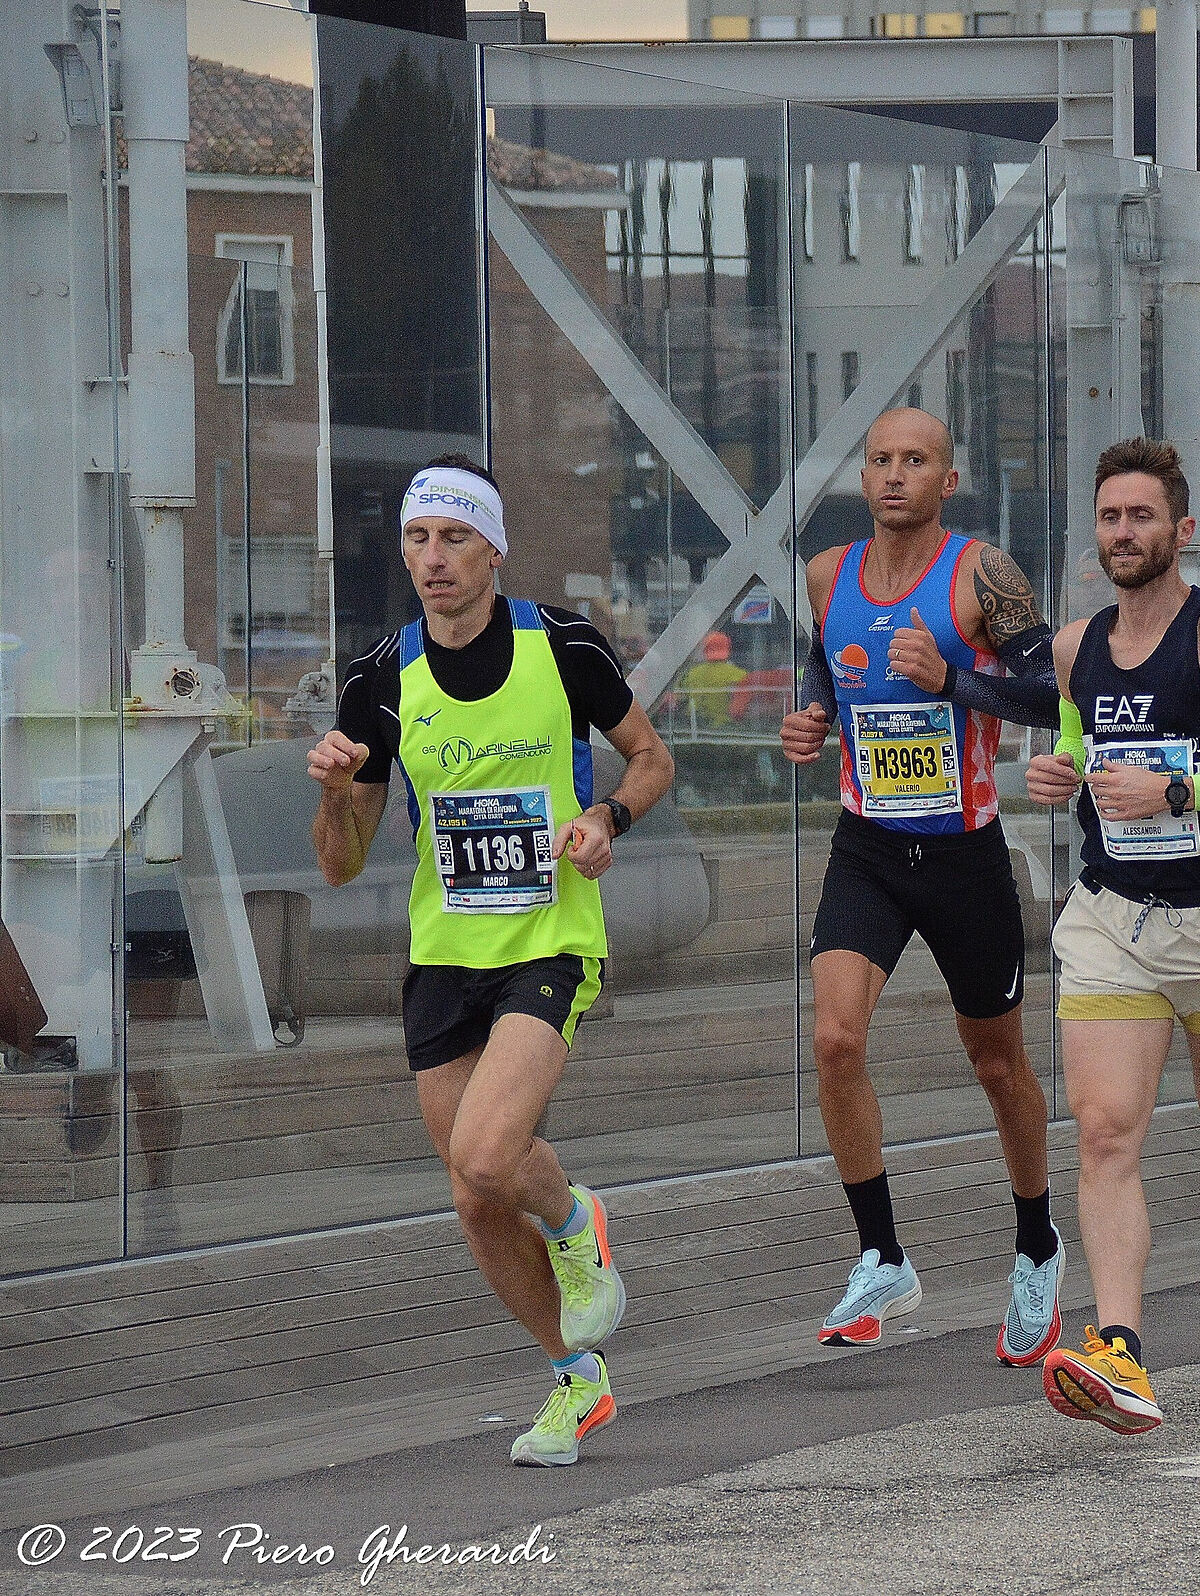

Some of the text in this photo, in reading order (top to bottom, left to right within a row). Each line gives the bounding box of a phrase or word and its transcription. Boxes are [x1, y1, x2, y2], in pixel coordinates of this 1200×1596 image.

[419, 494, 478, 513] SPORT
[1095, 695, 1154, 723] EA7
[499, 748, 552, 761] COMENDUNO
[874, 746, 938, 779] H3963
[895, 784, 920, 792] VALERIO
[474, 798, 500, 807] HOKA
[528, 797, 539, 809] BLU
[438, 819, 460, 827] 42,195
[1123, 826, 1162, 836] ALESSANDRO
[462, 835, 525, 871] 1136
[483, 876, 508, 887] MARCO
